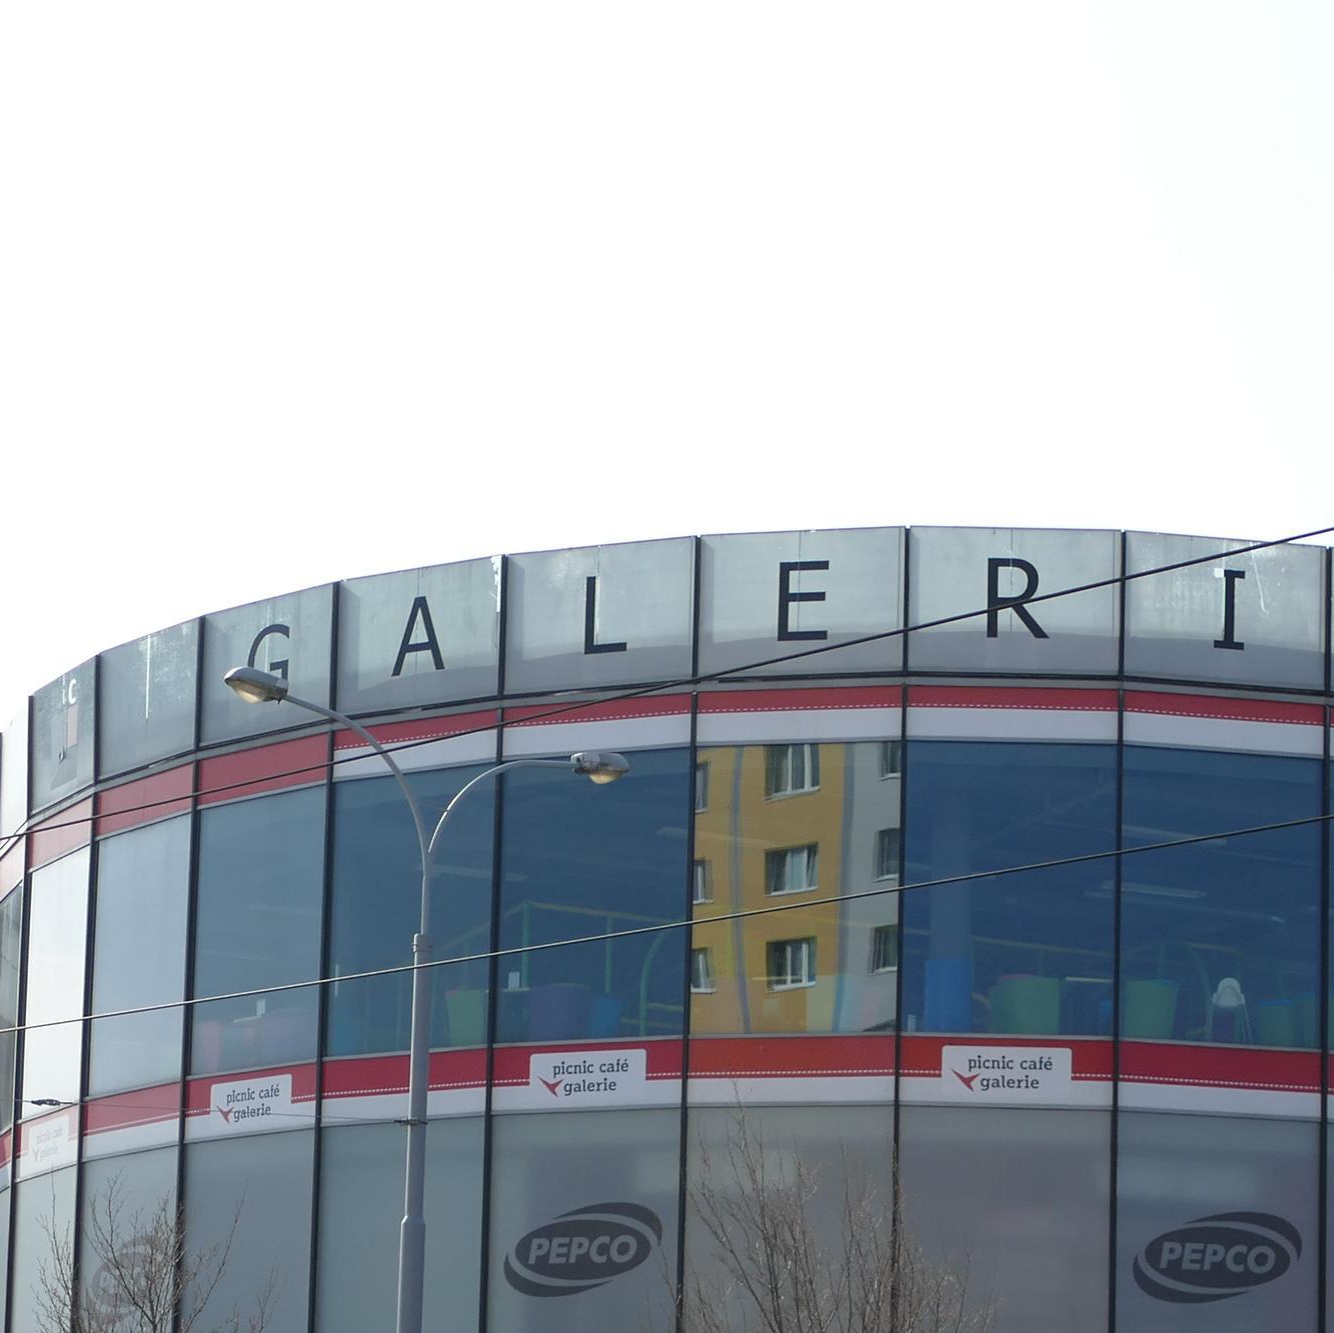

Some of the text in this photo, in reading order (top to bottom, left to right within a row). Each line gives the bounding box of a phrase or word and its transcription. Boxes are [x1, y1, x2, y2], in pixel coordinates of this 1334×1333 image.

[552, 1058, 629, 1078] picnic café
[968, 1055, 1053, 1072] picnic café
[564, 1078, 617, 1096] galerie
[980, 1075, 1040, 1092] galerie
[226, 1083, 280, 1106] picnic café
[233, 1103, 271, 1123] galerie
[527, 1234, 638, 1265] PEPCO
[1158, 1241, 1276, 1275] PEPCO
